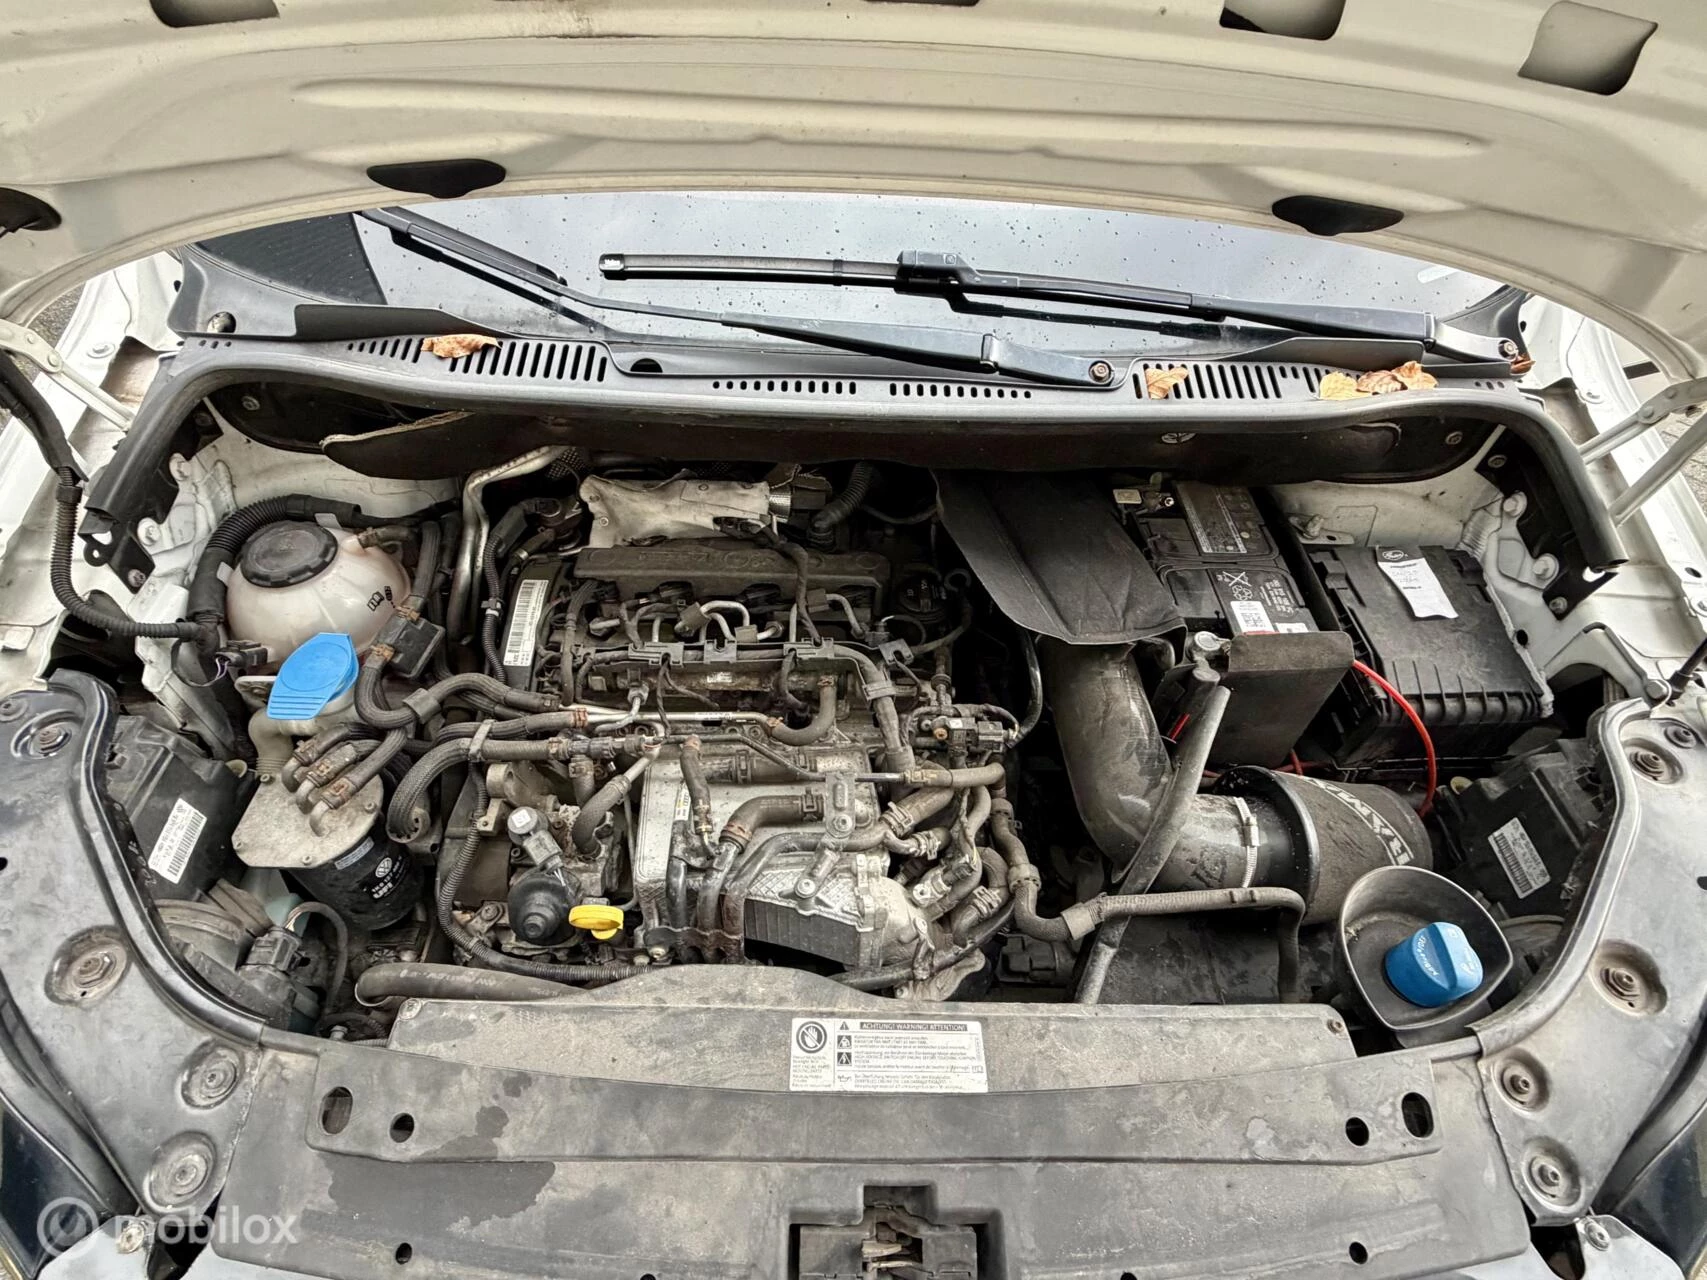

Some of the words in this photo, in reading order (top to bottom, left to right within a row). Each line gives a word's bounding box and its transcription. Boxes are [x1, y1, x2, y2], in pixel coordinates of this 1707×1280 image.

[863, 1022, 894, 1030] ACHTUNG!
[896, 1023, 928, 1031] WARNING!
[930, 1023, 965, 1032] ATTENTION!
